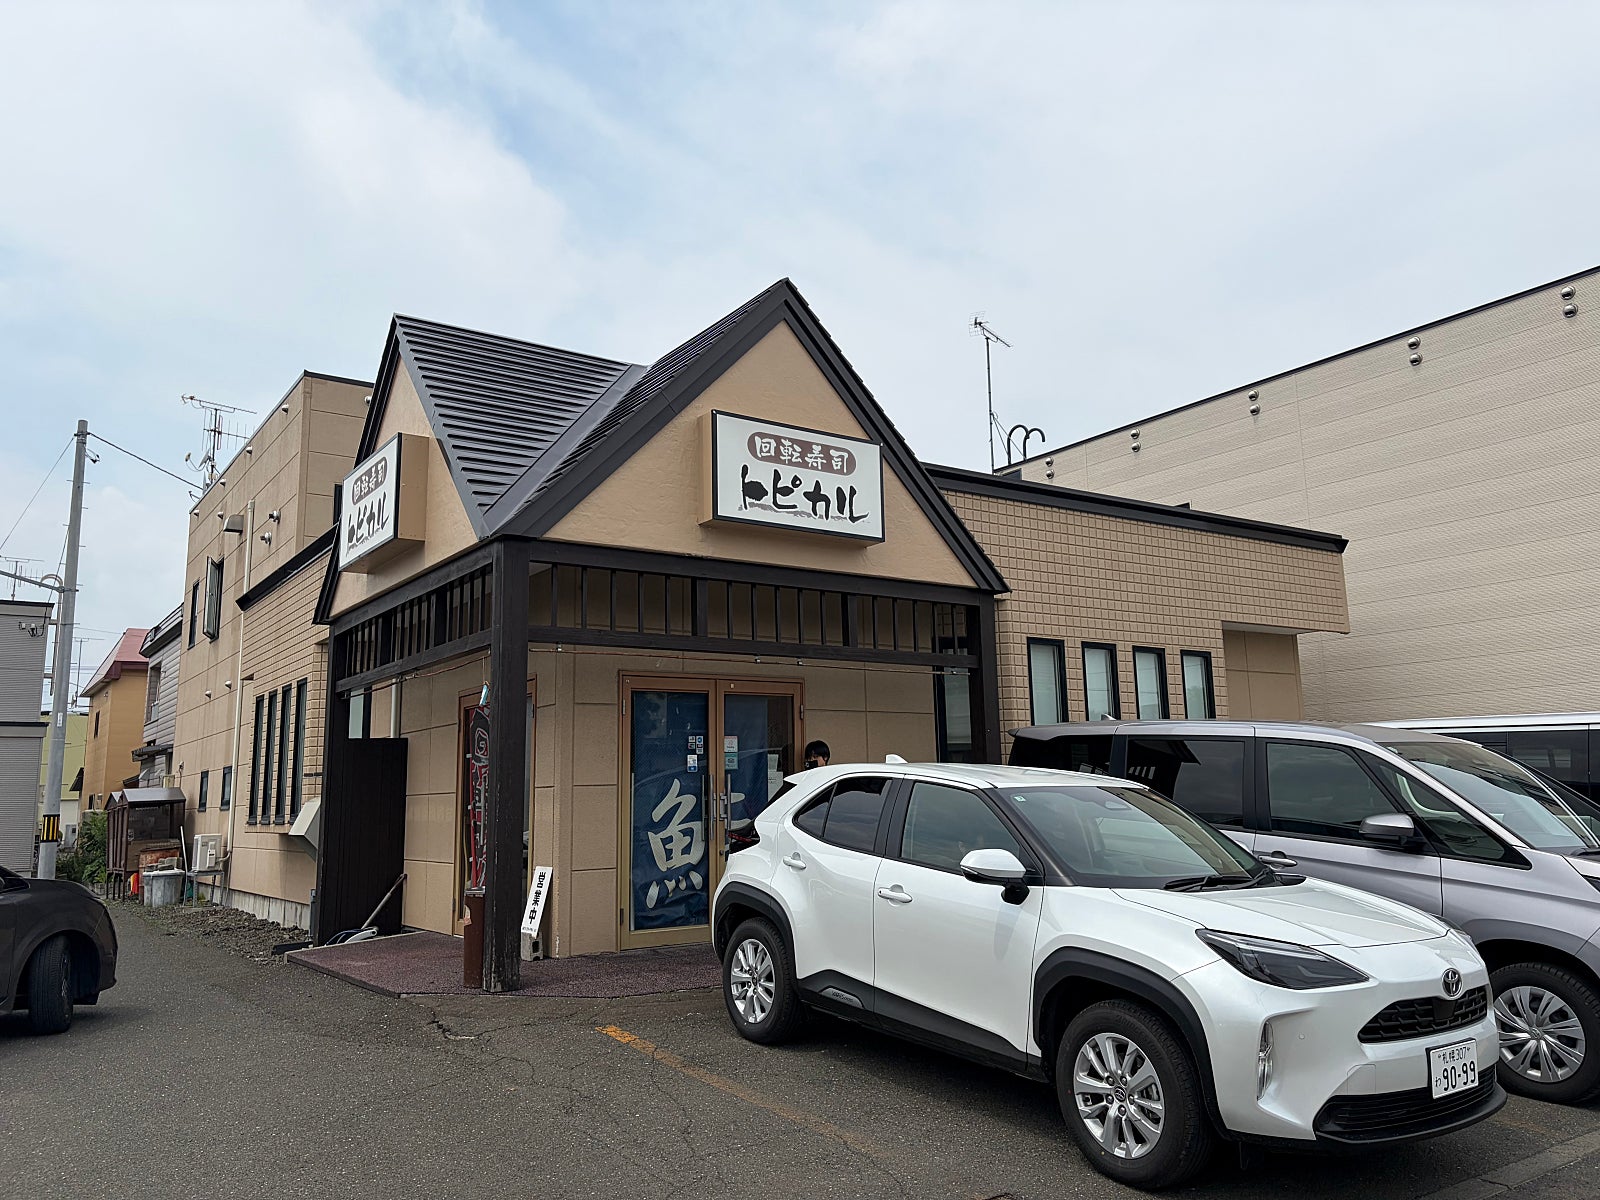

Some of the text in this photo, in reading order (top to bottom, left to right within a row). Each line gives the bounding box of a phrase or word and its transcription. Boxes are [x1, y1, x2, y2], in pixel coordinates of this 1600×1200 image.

[353, 460, 386, 503] 回転寿司
[754, 435, 849, 474] 回転寿司
[347, 491, 389, 551] トピカル
[740, 464, 869, 524] トピカル
[646, 778, 706, 909] 魚
[528, 871, 547, 925] 営業中
[1435, 1060, 1477, 1092] わ 90-99
